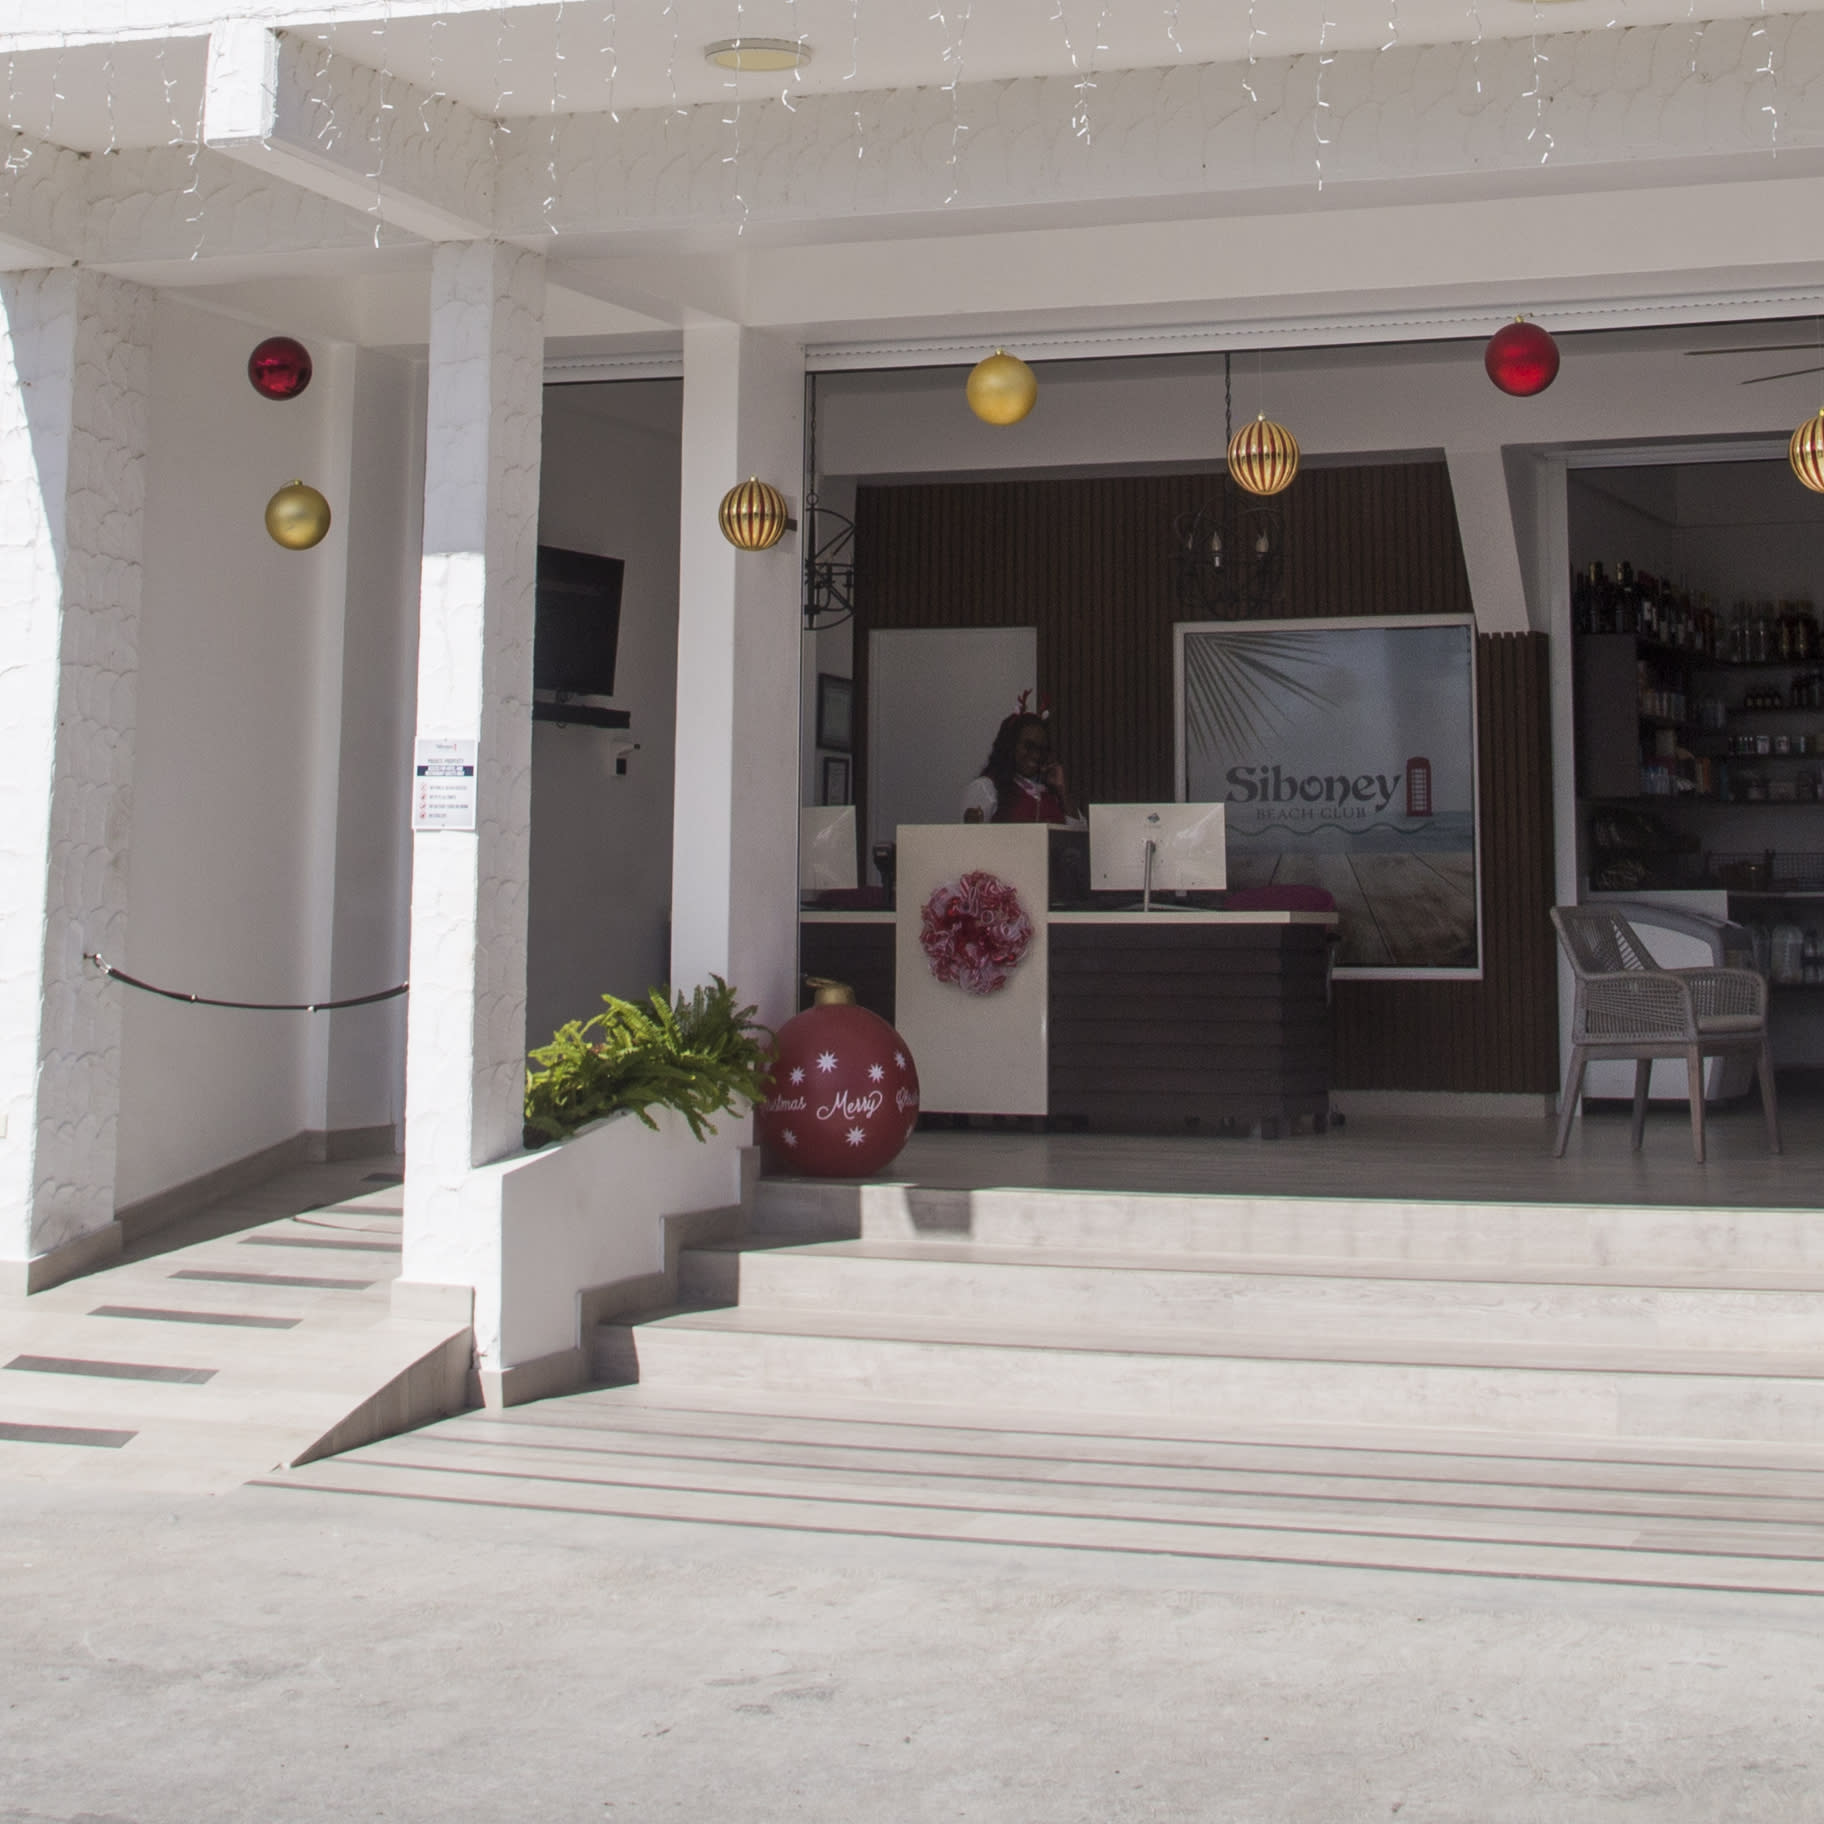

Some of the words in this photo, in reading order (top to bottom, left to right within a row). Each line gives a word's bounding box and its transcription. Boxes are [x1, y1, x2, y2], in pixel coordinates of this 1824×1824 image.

[1225, 765, 1402, 813] Siboney
[1256, 807, 1313, 820] BEACH
[1320, 806, 1367, 819] CLUB
[816, 1089, 883, 1121] Merry
